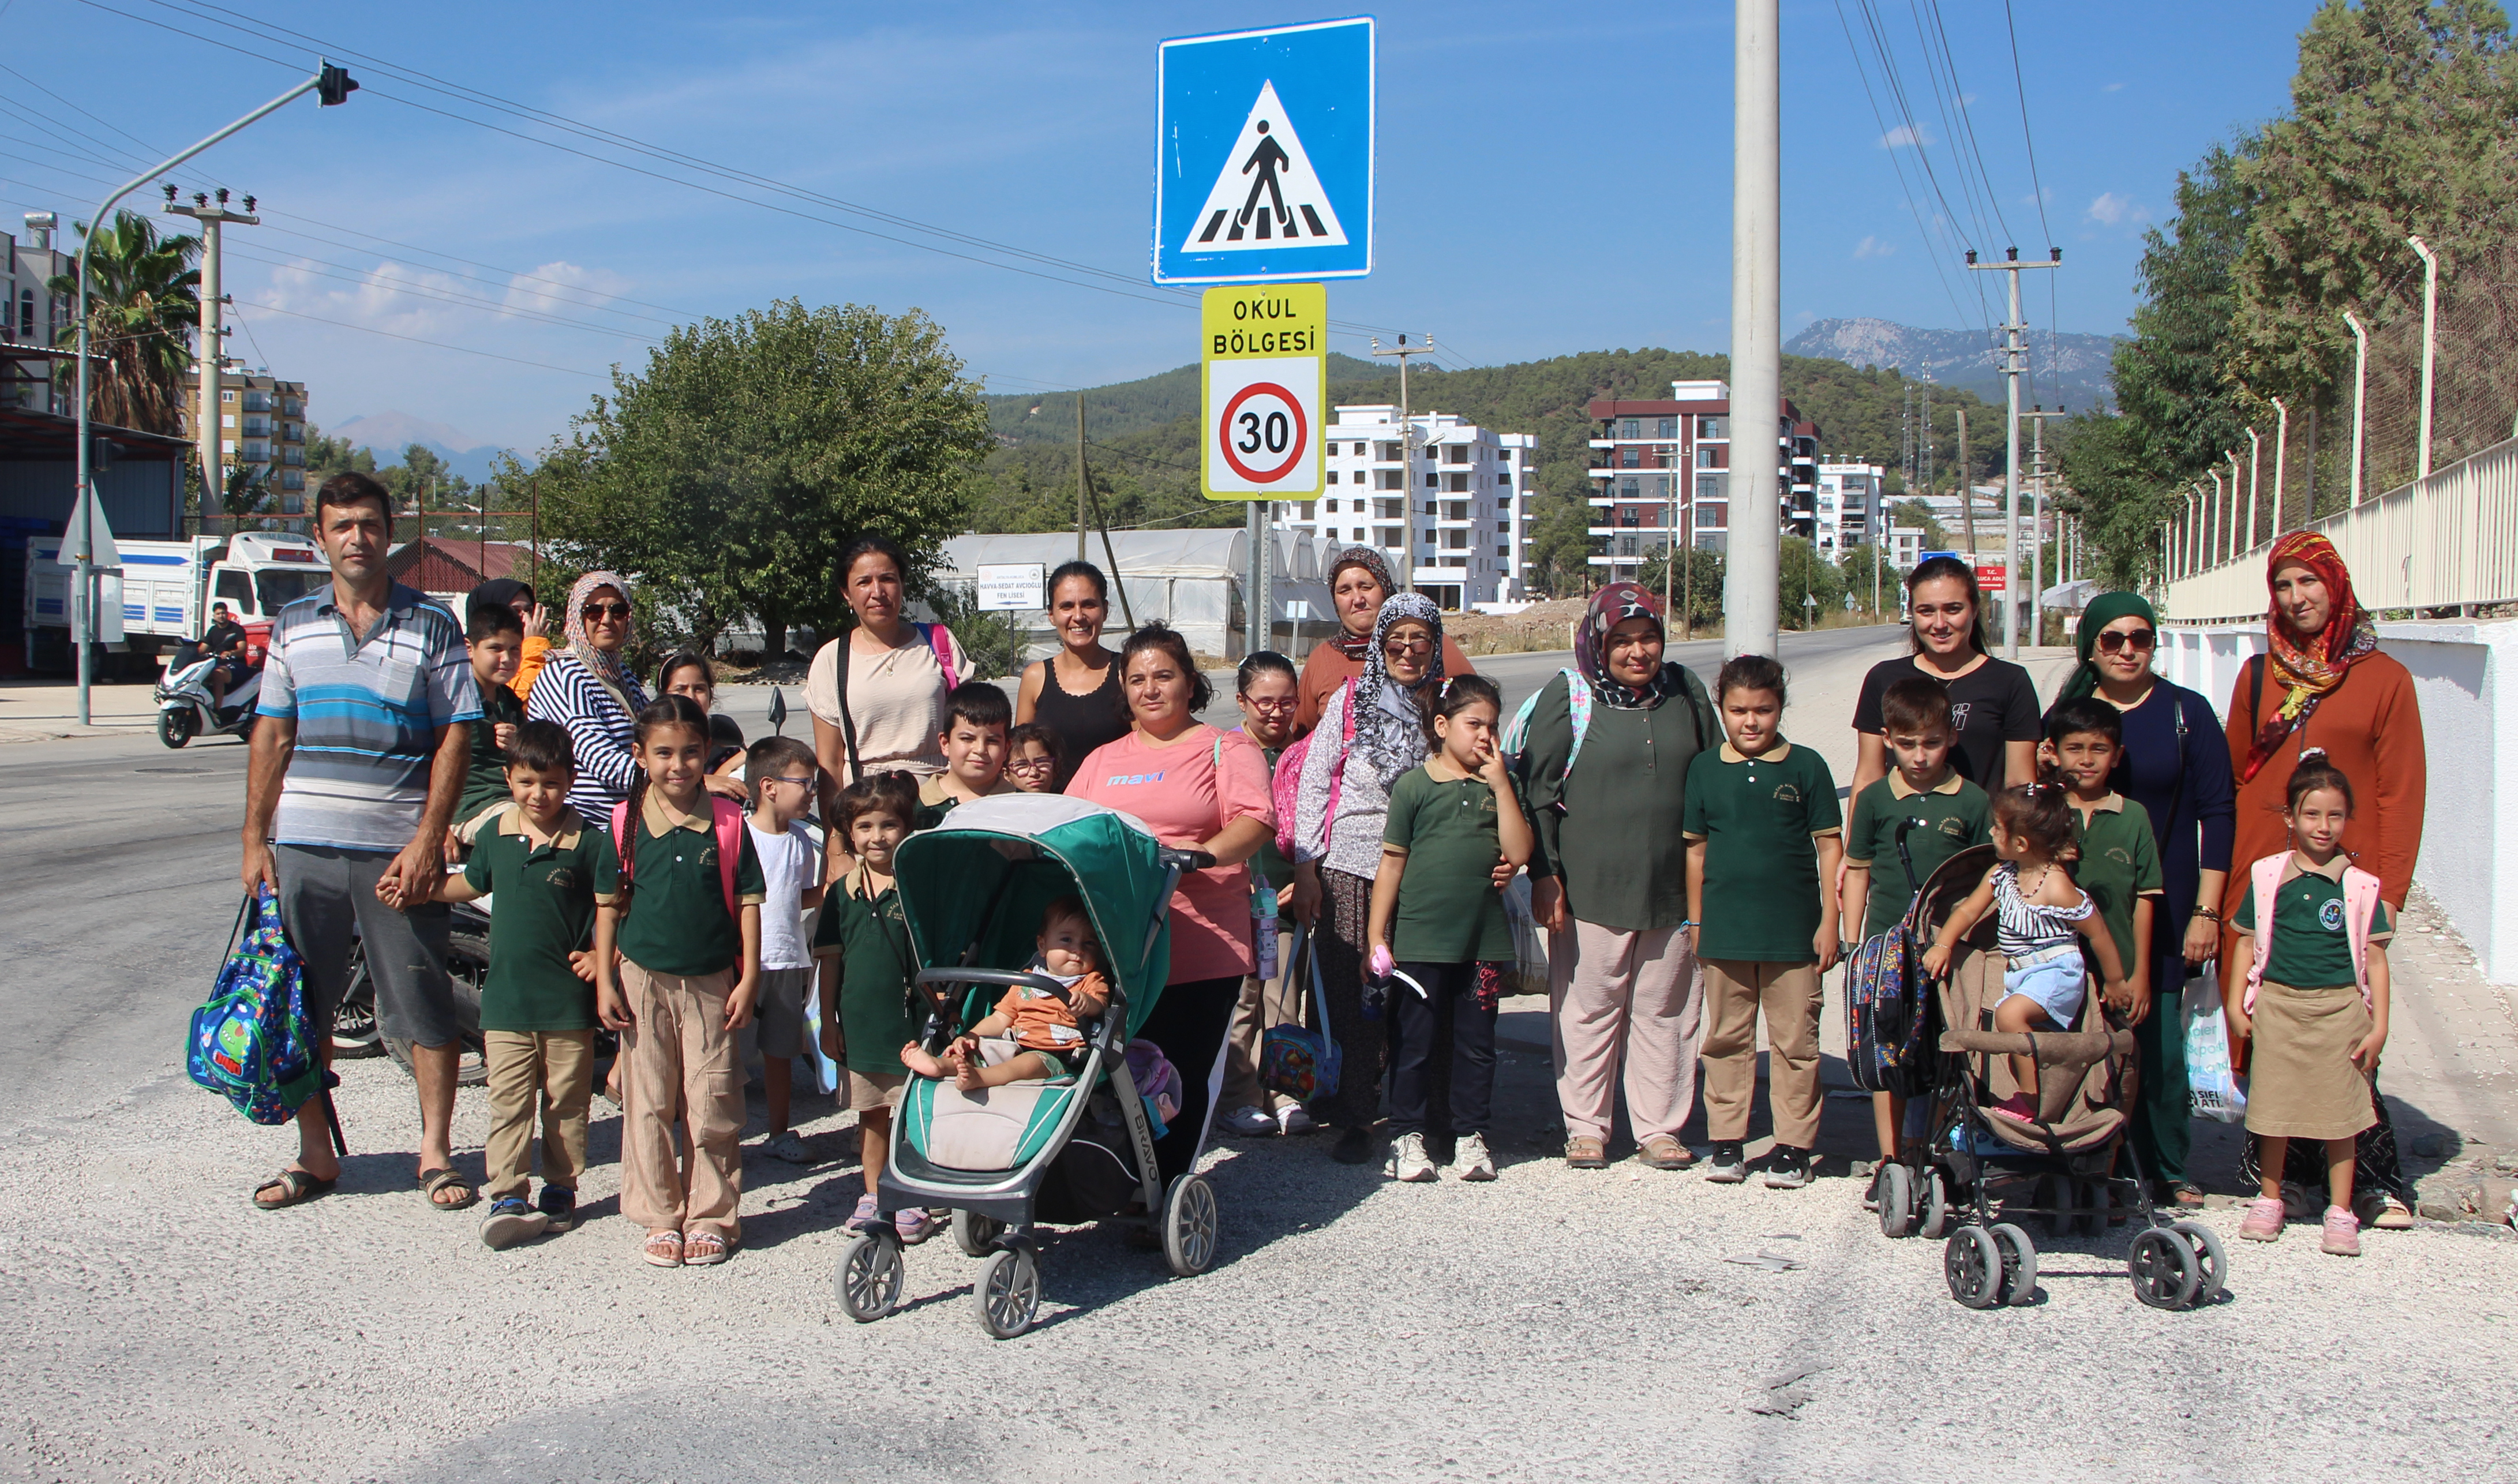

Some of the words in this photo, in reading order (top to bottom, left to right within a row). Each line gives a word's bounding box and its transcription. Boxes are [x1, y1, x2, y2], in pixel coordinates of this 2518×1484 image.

[1234, 298, 1297, 320] OKUL
[1213, 325, 1316, 354] BÖLGESİ
[1237, 411, 1288, 454] 30
[1106, 769, 1167, 787] mavi
[1134, 1113, 1157, 1182] BRAVO
